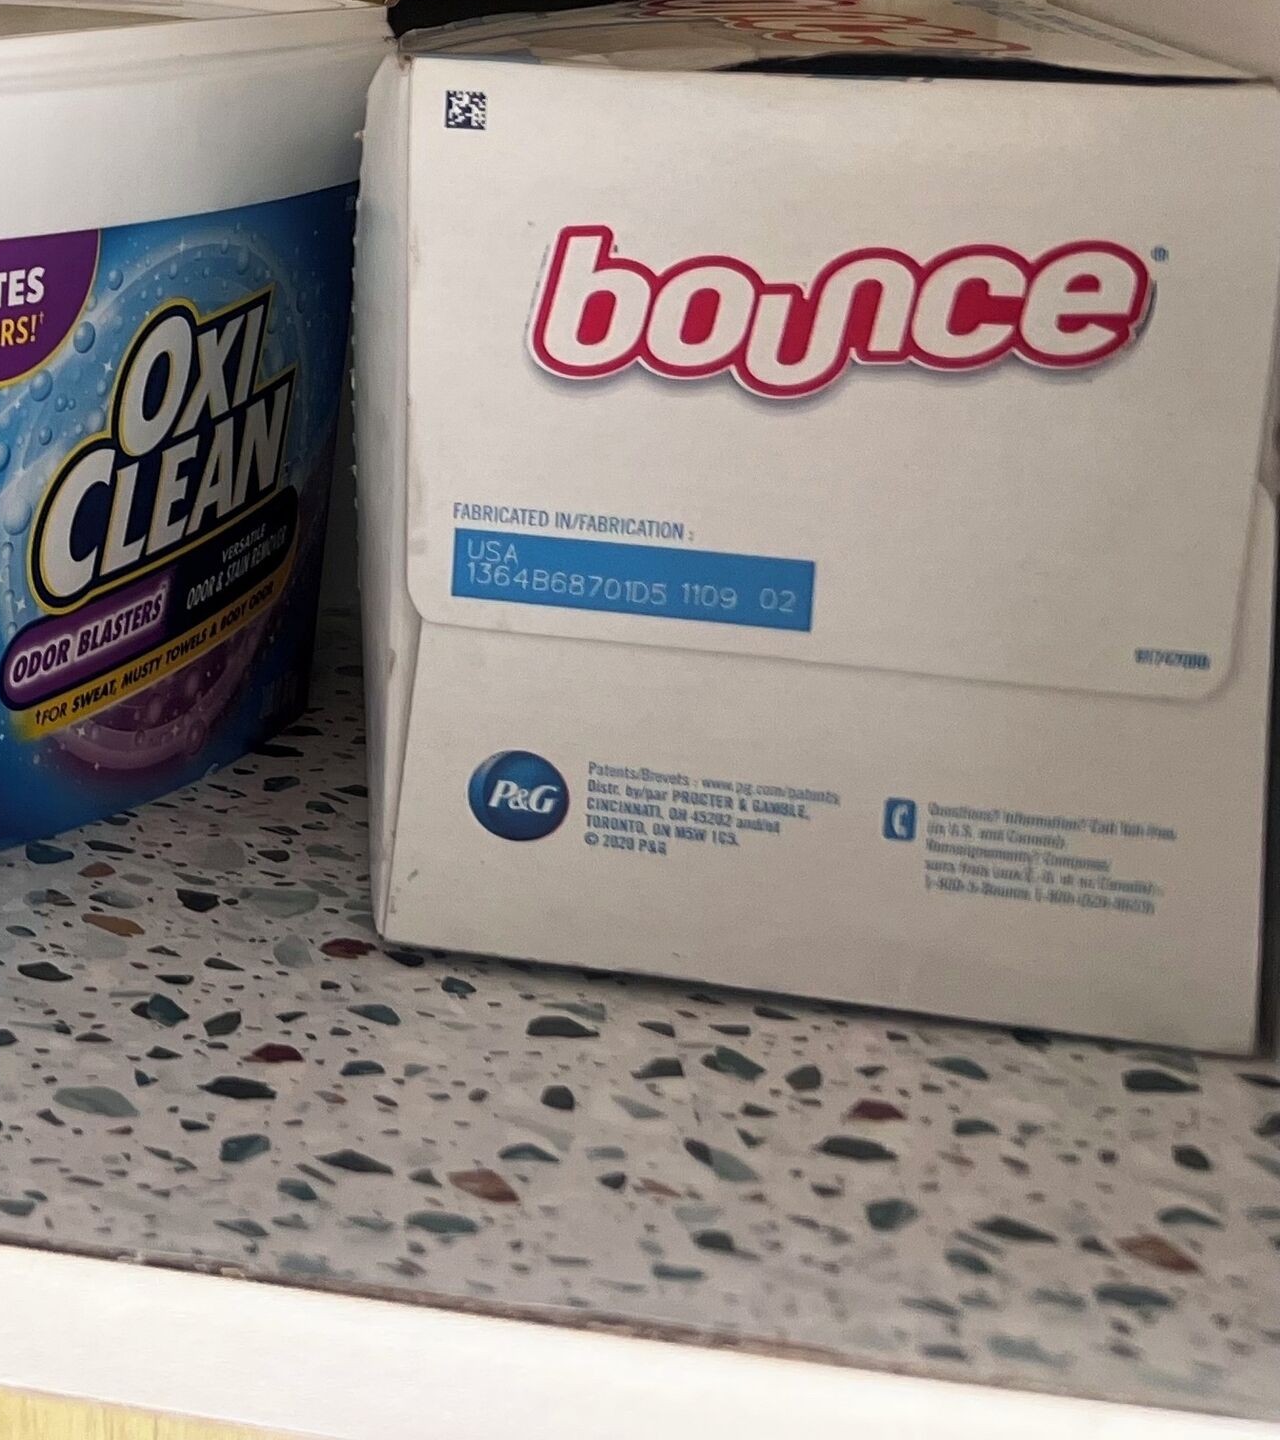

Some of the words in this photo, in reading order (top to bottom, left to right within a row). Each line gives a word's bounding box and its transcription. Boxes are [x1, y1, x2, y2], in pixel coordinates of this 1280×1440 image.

[533, 224, 1152, 400] bounce
[119, 305, 264, 457] OXI
[40, 380, 290, 598] CLEAN
[453, 502, 549, 527] FABRICATED
[554, 513, 685, 541] IN/FABRICATION
[221, 523, 267, 564] VERSATILE
[467, 539, 519, 567] USA
[186, 575, 216, 610] ODOR
[681, 583, 738, 610] 1109
[759, 587, 797, 613] 02
[12, 638, 71, 684] ODOR
[71, 681, 117, 714] SWEAT,
[120, 655, 164, 691] MUSTY
[165, 627, 208, 666] TOWELS
[488, 779, 560, 814] P&G
[671, 789, 733, 809] PROCTER
[585, 813, 649, 836] TORONTO,
